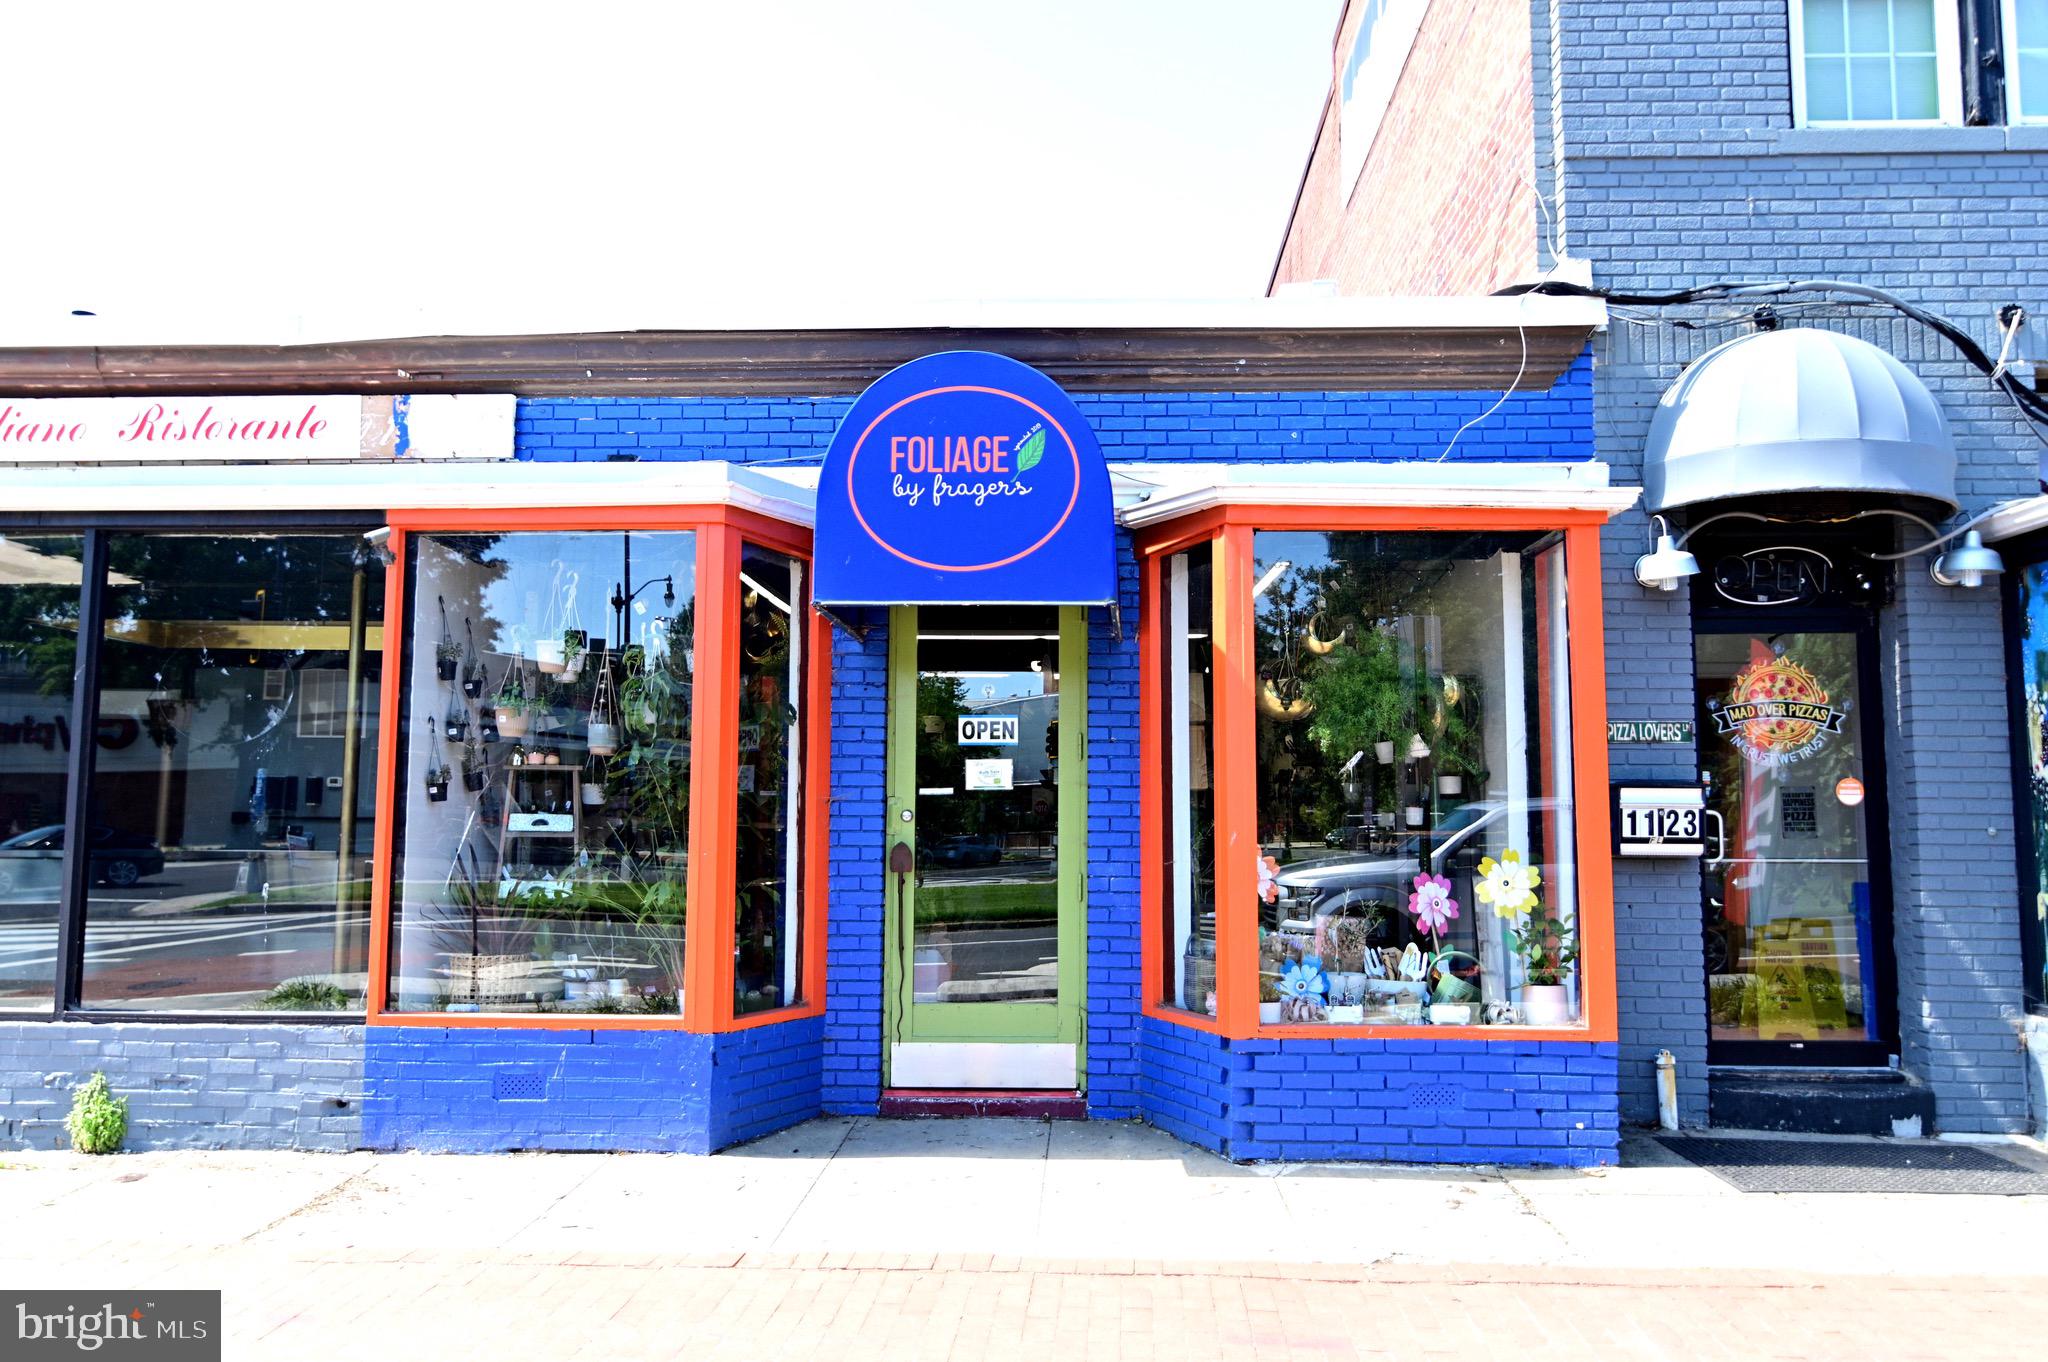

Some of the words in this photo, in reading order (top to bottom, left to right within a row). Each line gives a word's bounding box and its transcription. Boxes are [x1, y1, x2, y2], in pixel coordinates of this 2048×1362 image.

[118, 403, 327, 441] Ristorante
[891, 436, 1010, 473] FOLIAGE
[893, 474, 926, 506] by
[1729, 705, 1756, 721] MAD
[1757, 703, 1786, 717] OVER
[1789, 704, 1828, 721] PIZZAS
[962, 720, 1015, 740] OPEN
[1608, 723, 1637, 741] PIZZA
[1640, 723, 1681, 741] LOVERS
[1730, 734, 1744, 748] IN
[1742, 744, 1776, 760] CRUST
[1777, 751, 1798, 764] WE
[1797, 732, 1827, 759] TRUST
[1627, 810, 1697, 836] 1123
[1783, 812, 1816, 820] PIZZA
